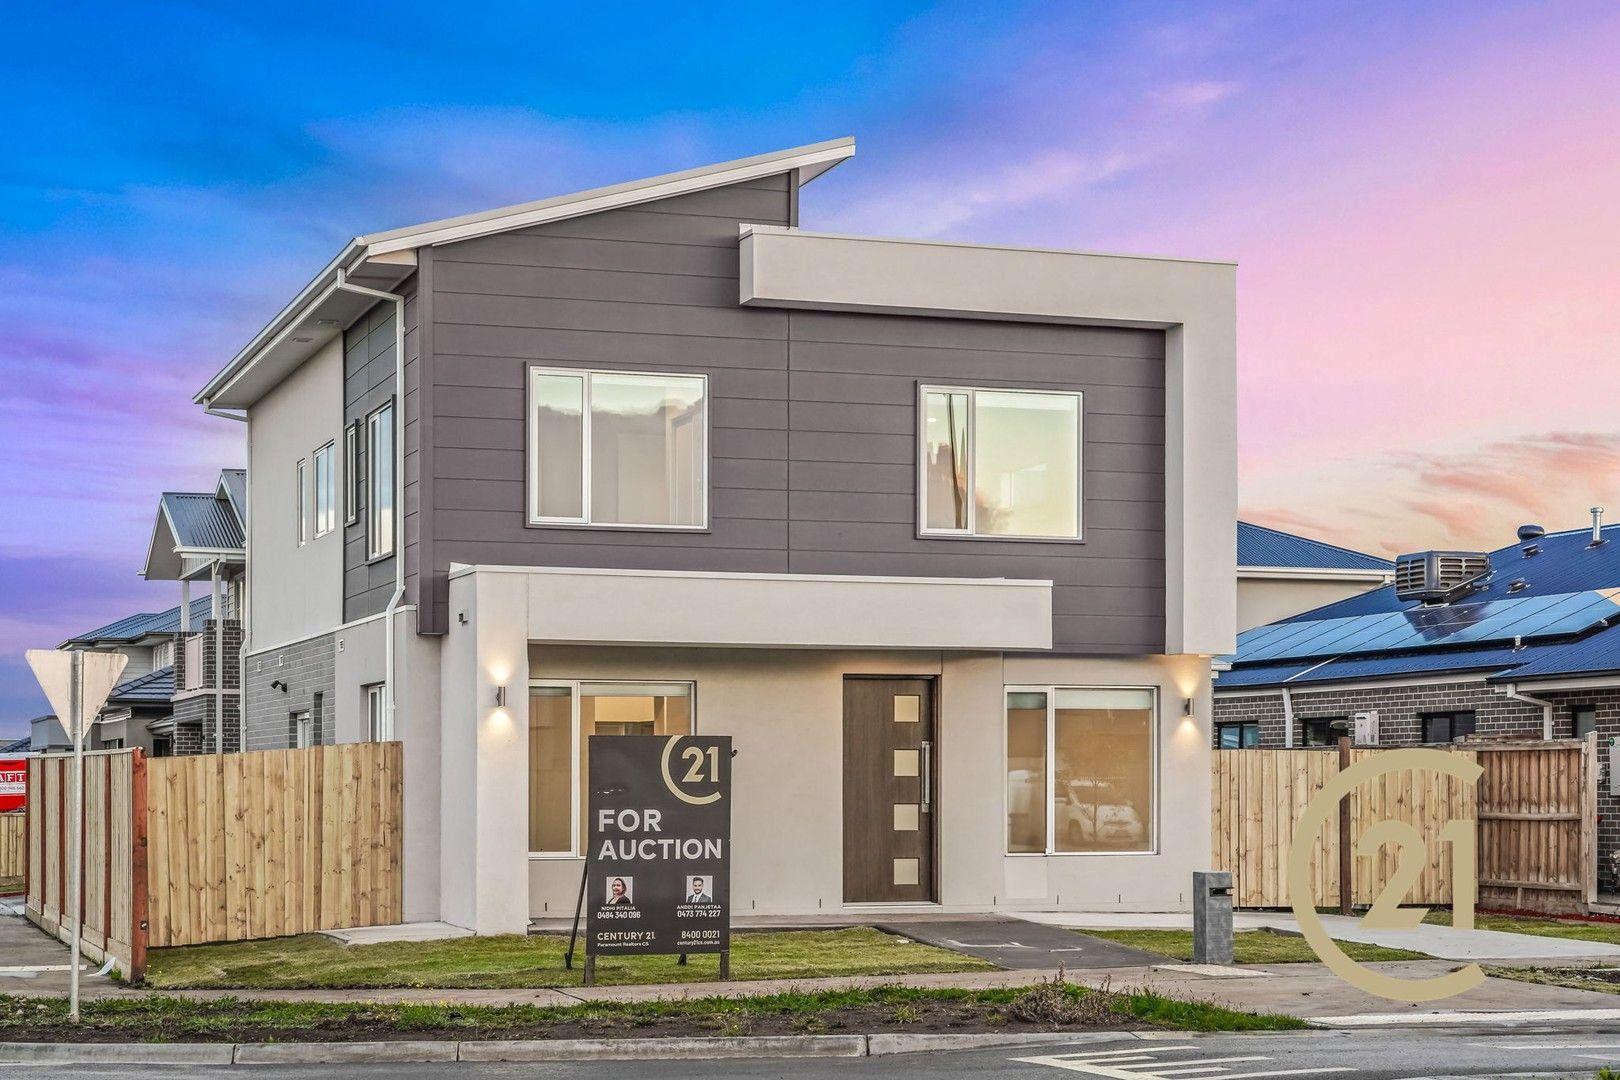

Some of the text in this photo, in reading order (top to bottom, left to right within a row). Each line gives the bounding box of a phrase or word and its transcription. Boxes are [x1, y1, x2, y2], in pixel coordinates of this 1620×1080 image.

[598, 808, 662, 832] FOR
[598, 838, 722, 860] AUCTION
[597, 911, 614, 919] 0484
[615, 911, 628, 919] 340
[677, 910, 721, 918] 0473 774 227
[597, 931, 656, 941] CENTURY 21
[681, 930, 720, 939] 8400 0021
